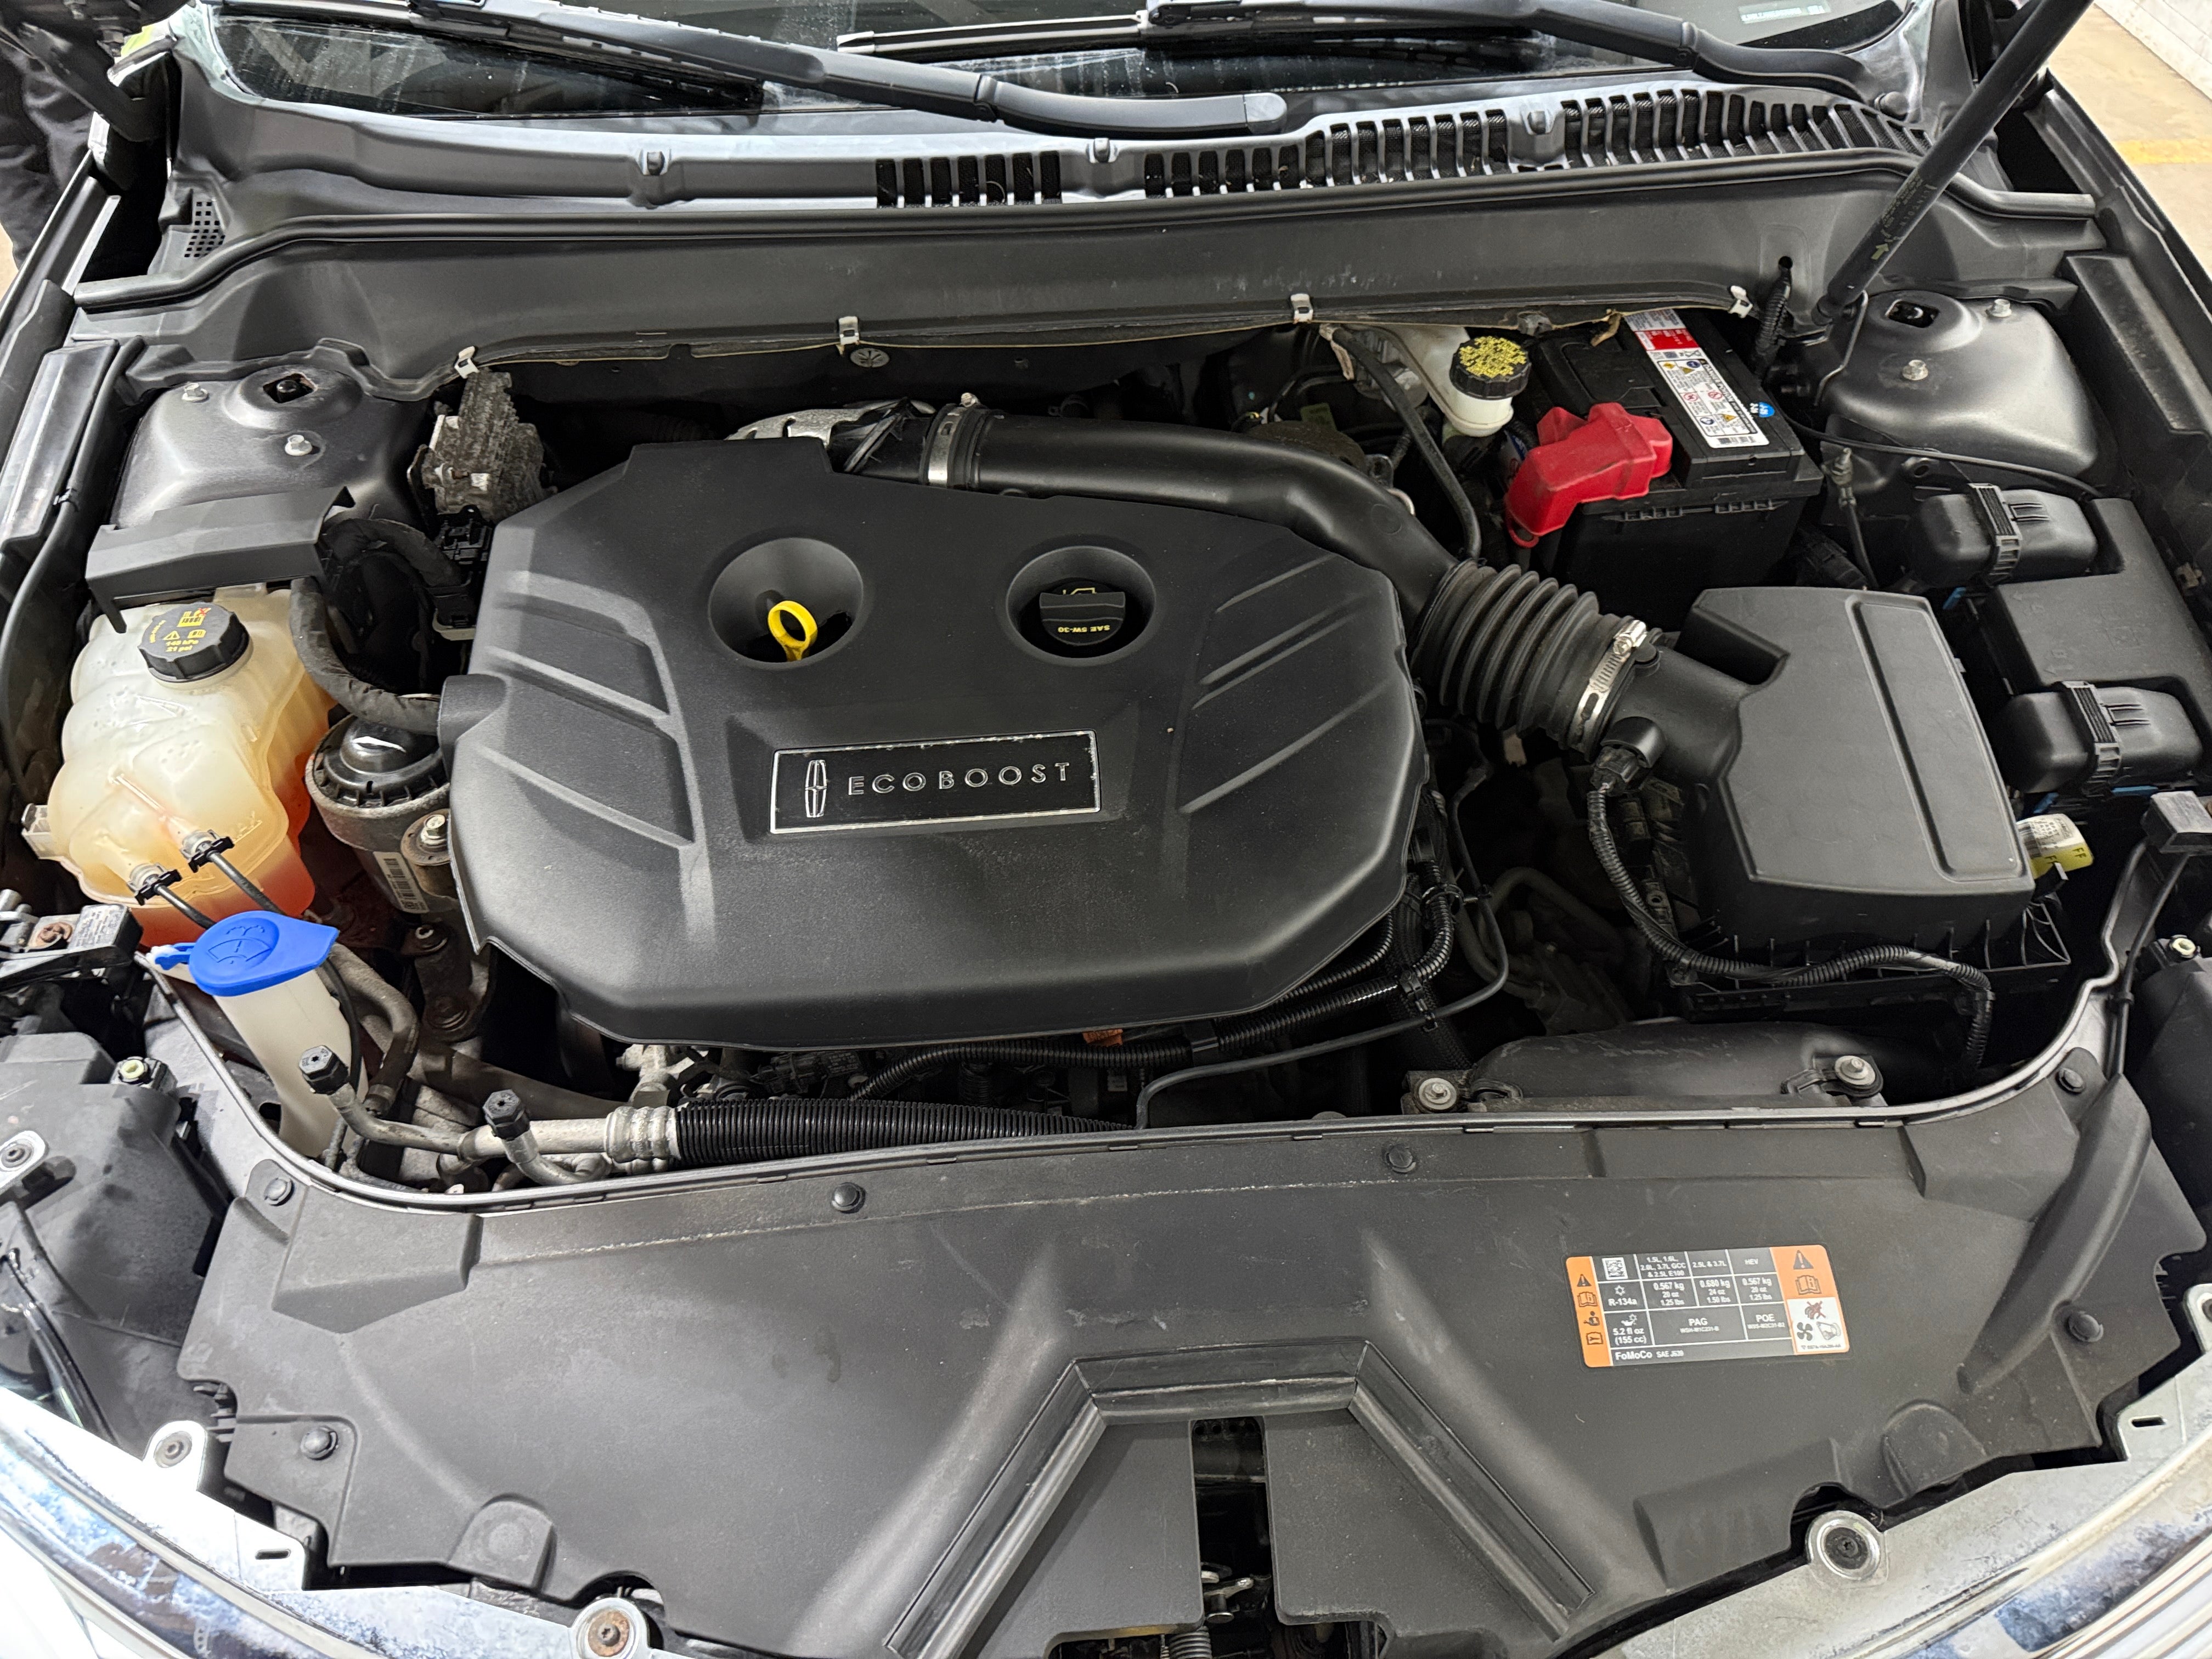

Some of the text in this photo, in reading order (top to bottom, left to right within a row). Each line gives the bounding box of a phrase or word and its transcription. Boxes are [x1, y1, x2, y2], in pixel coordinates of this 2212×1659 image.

[848, 761, 1070, 795] ECOBOOST
[2072, 848, 2087, 859] FF
[1720, 1279, 1731, 1289] kg
[1742, 1277, 1773, 1286] 0.567 kg
[1653, 1282, 1685, 1291] 0.567 kg
[1608, 1297, 1638, 1306] R-134a
[1688, 1318, 1708, 1326] PAG
[1756, 1313, 1776, 1322] POE
[1613, 1328, 1626, 1336] 5.2
[1615, 1335, 1647, 1346] (155 cc)
[1615, 1350, 1653, 1360] FoMoCo
